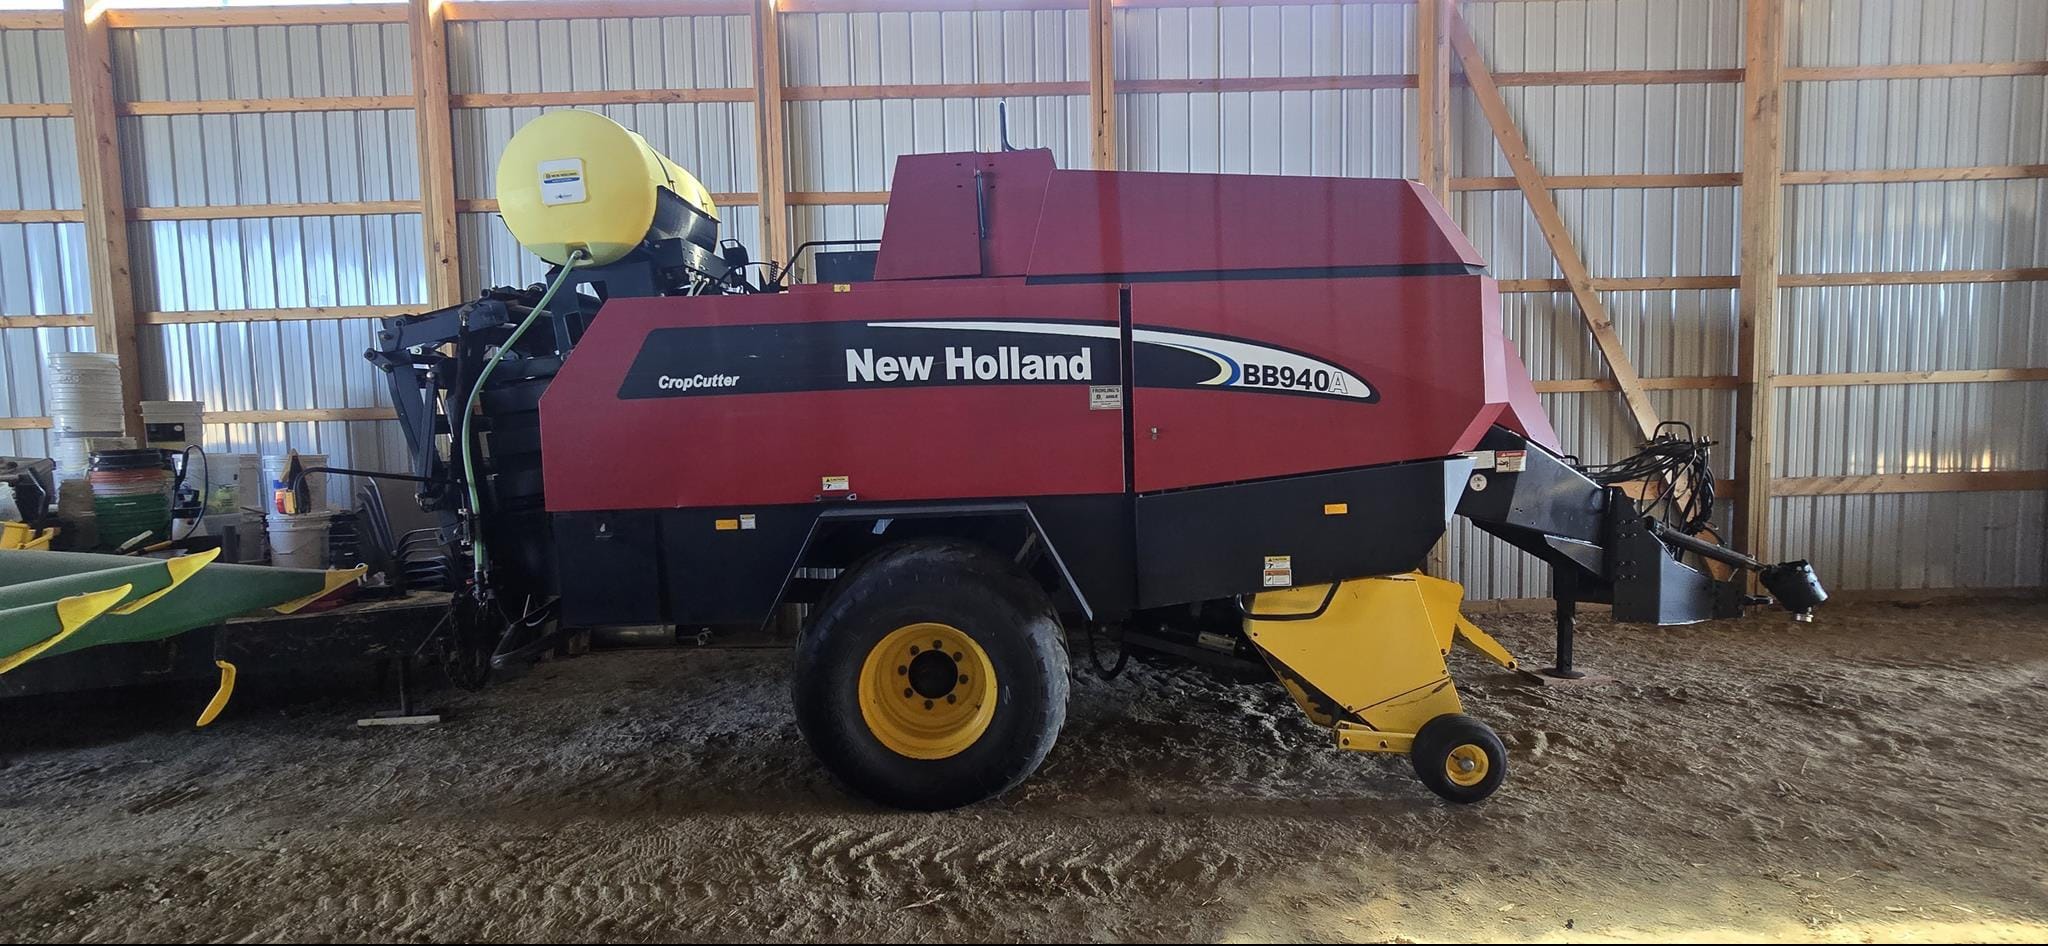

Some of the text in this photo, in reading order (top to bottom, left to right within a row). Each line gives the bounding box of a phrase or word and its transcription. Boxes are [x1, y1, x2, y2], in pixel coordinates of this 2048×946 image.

[846, 346, 1092, 381] New Holland
[1243, 363, 1348, 394] BB940A
[658, 373, 740, 392] CropCutter
